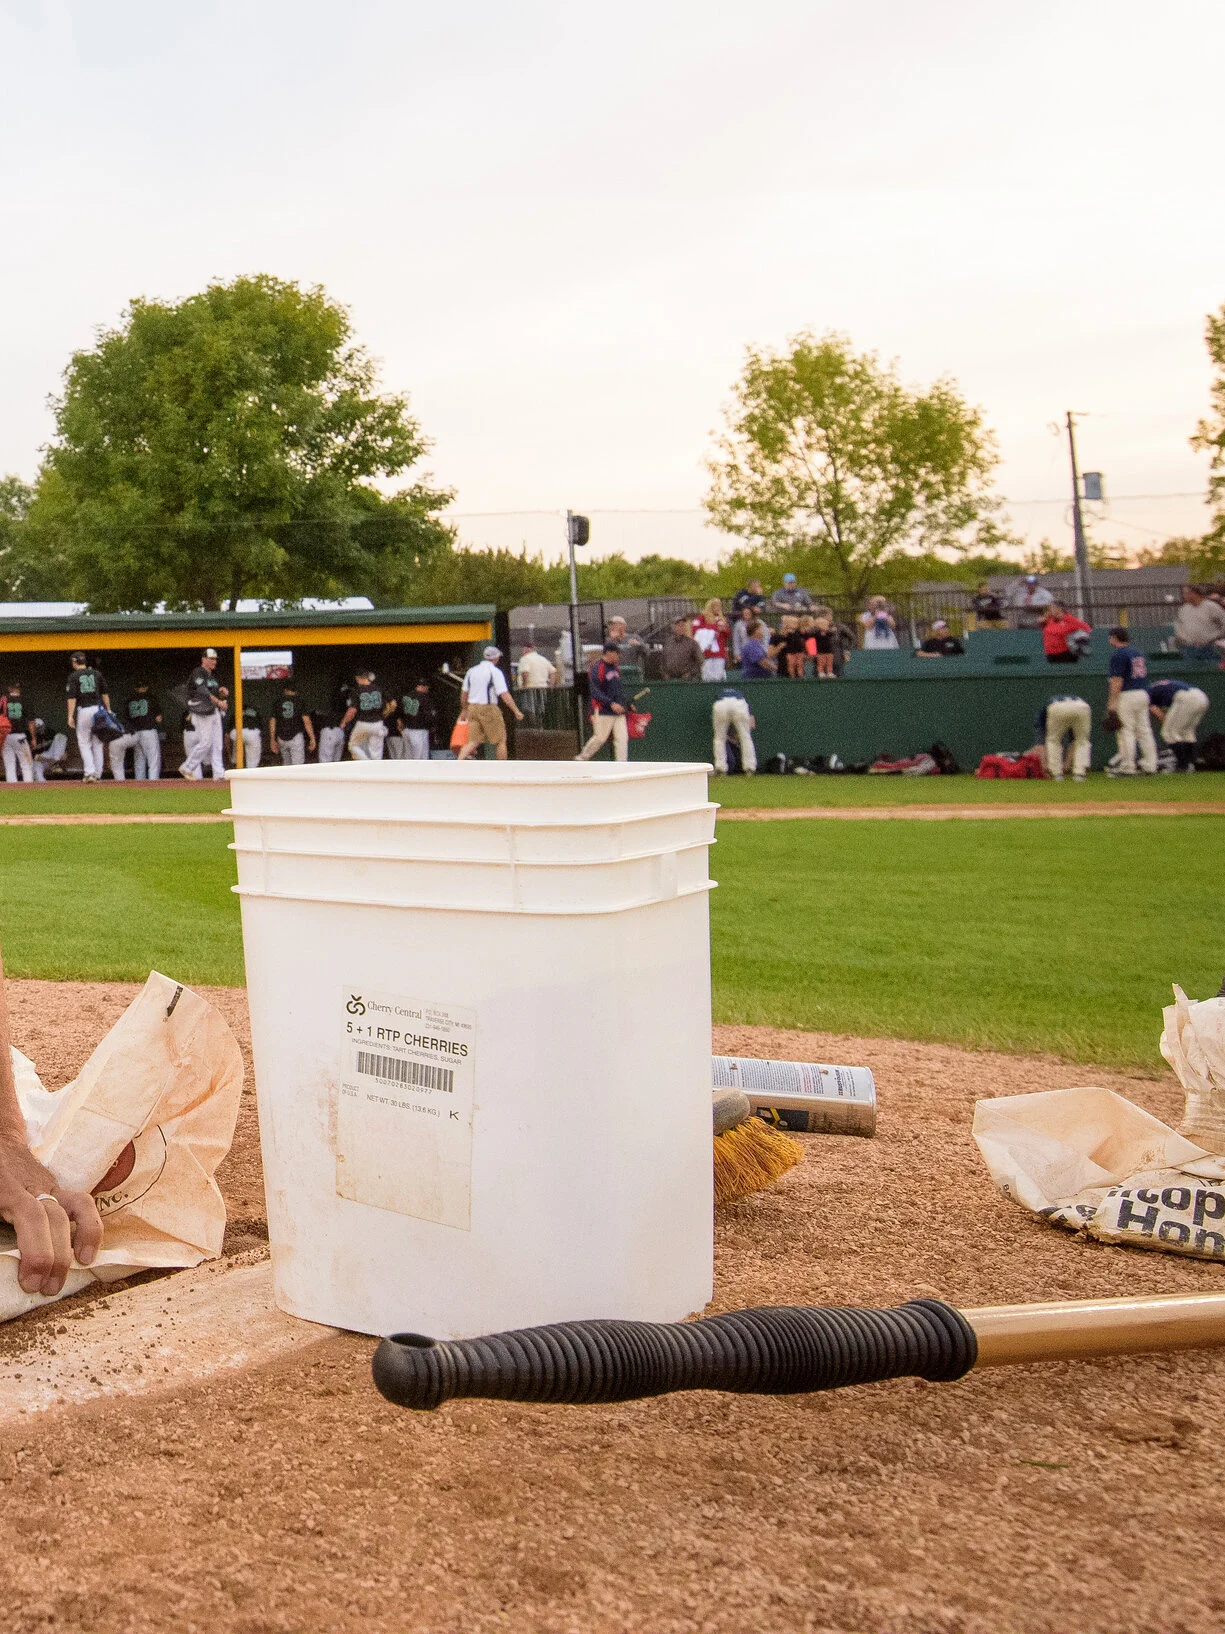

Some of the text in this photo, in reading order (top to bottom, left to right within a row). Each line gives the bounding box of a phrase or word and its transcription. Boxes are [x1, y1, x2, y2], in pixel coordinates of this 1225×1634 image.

[367, 1000, 422, 1020] Cherry Central
[346, 1021, 469, 1057] 5 + 1 RTP CHERRIES
[392, 1044, 407, 1054] TART
[440, 1055, 462, 1066] SUGAR
[367, 1094, 378, 1102] NET
[390, 1099, 398, 1107] 30
[449, 1110, 460, 1121] K
